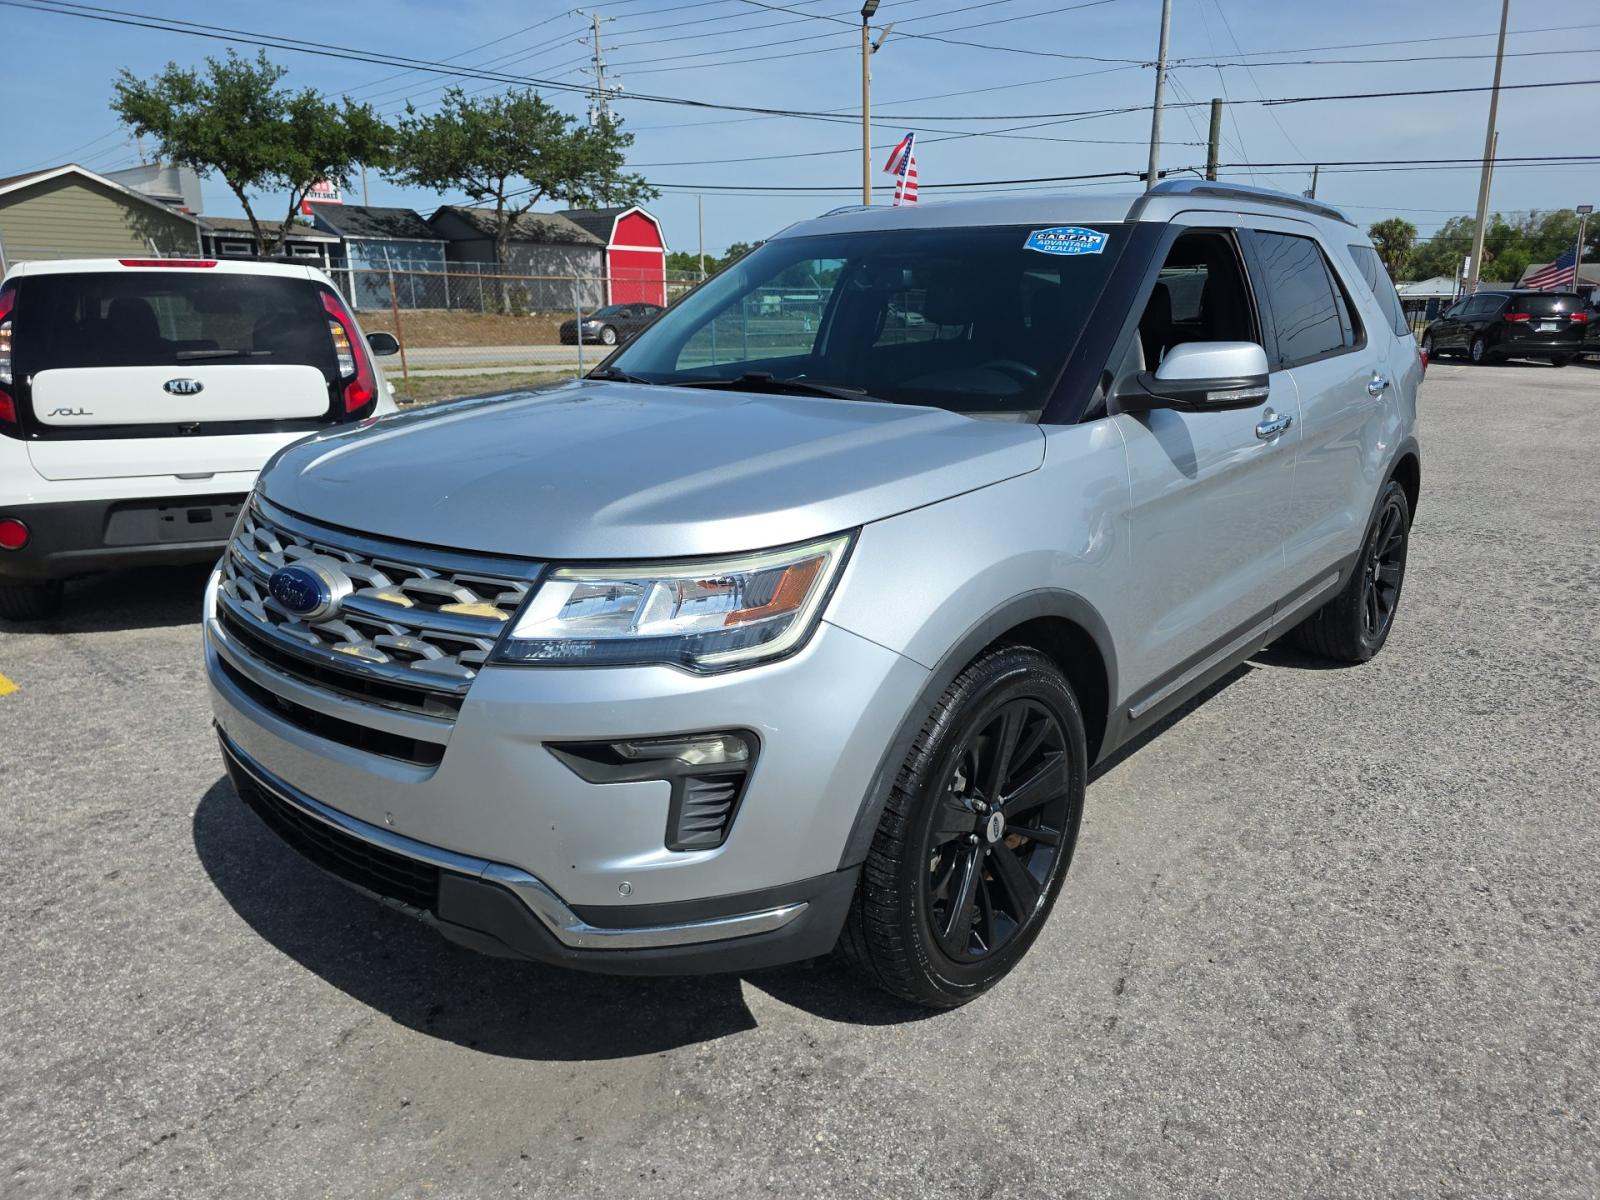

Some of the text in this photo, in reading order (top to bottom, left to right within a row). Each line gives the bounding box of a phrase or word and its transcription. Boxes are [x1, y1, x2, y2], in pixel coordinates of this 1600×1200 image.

[1036, 233, 1101, 243] CARFAX
[1036, 239, 1093, 248] ADVANTAGE
[1044, 245, 1081, 253] DEALER
[167, 380, 199, 393] KIA
[47, 407, 94, 417] SOUL
